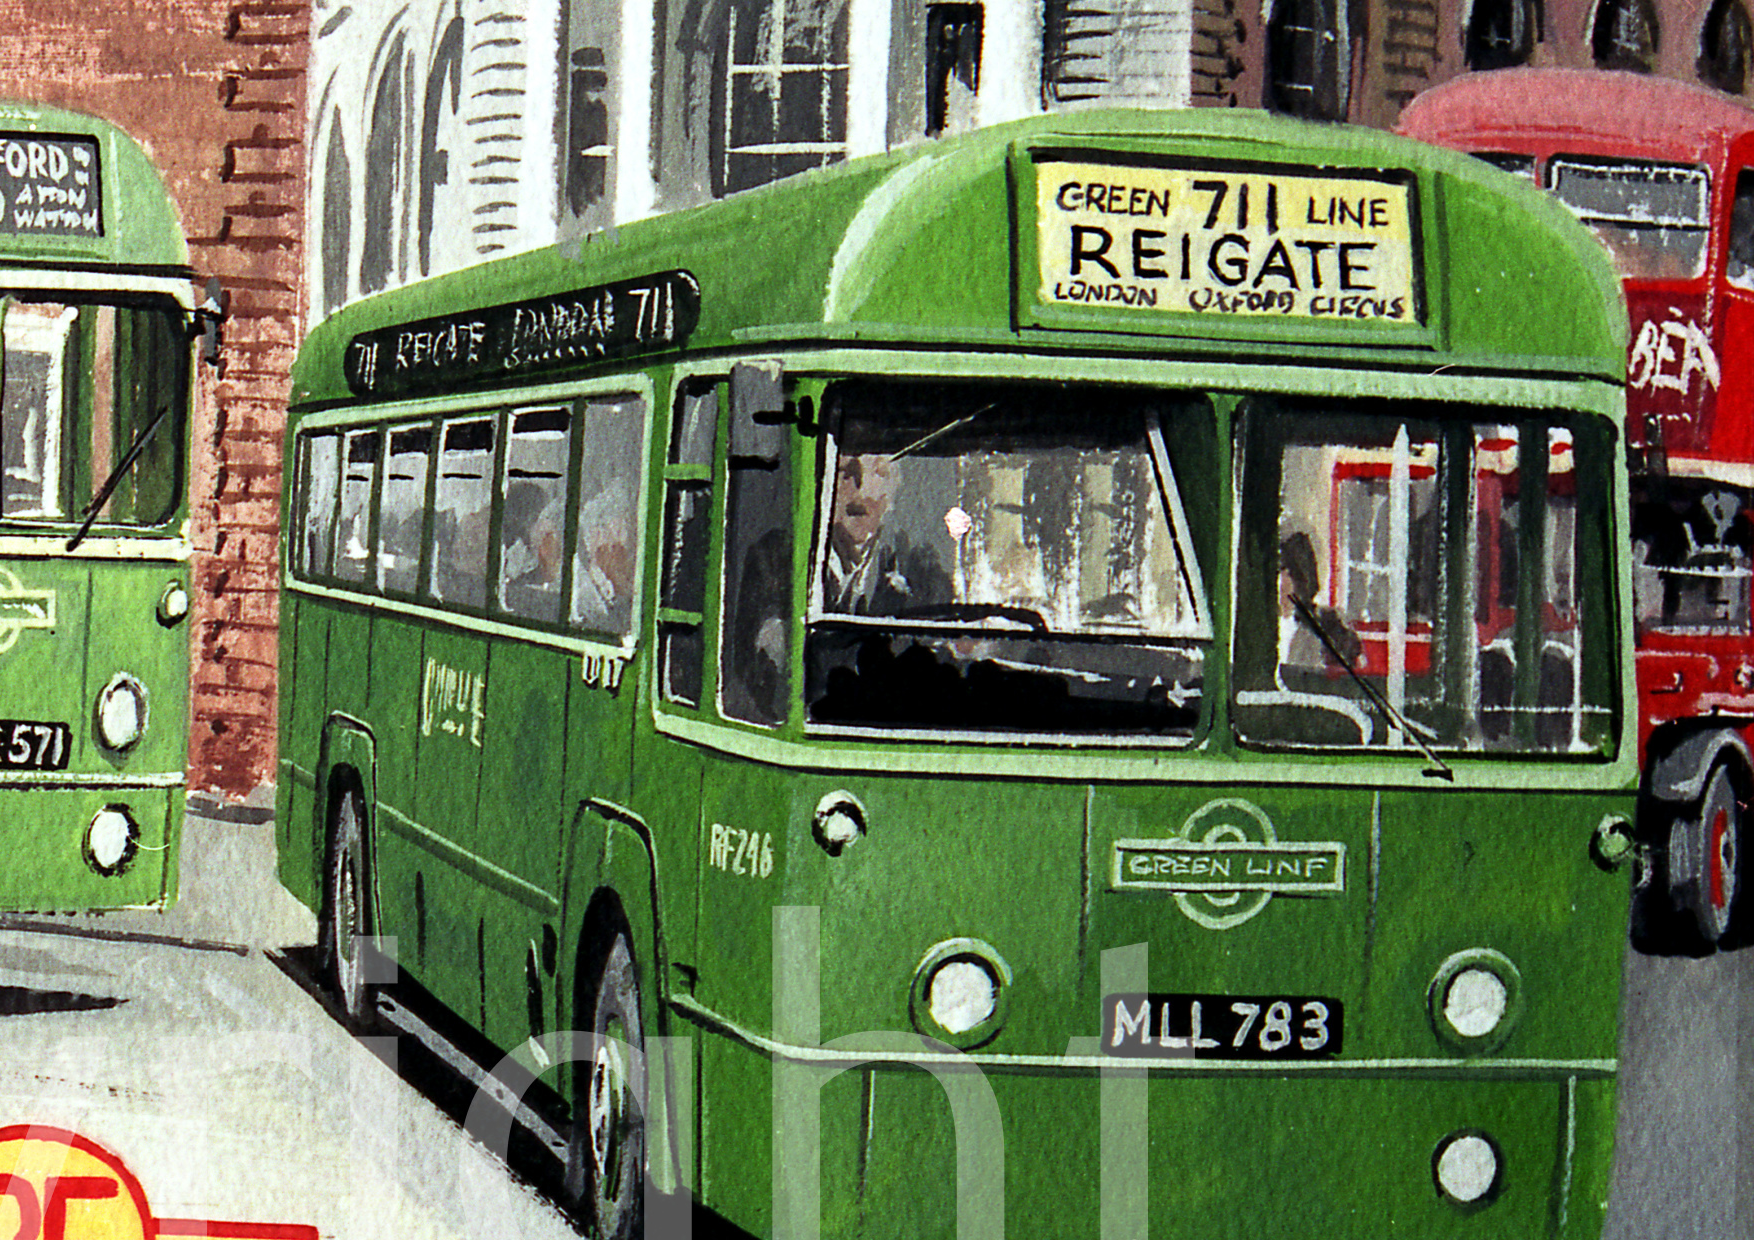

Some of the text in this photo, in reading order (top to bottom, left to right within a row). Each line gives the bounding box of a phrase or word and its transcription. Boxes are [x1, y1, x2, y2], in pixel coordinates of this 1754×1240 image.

[1055, 180, 1390, 235] GREEN 711 LINE
[1069, 225, 1378, 291] REIGATE
[628, 281, 674, 343] 711
[1054, 281, 1158, 308] LONDON
[1129, 855, 1231, 877] GREEN
